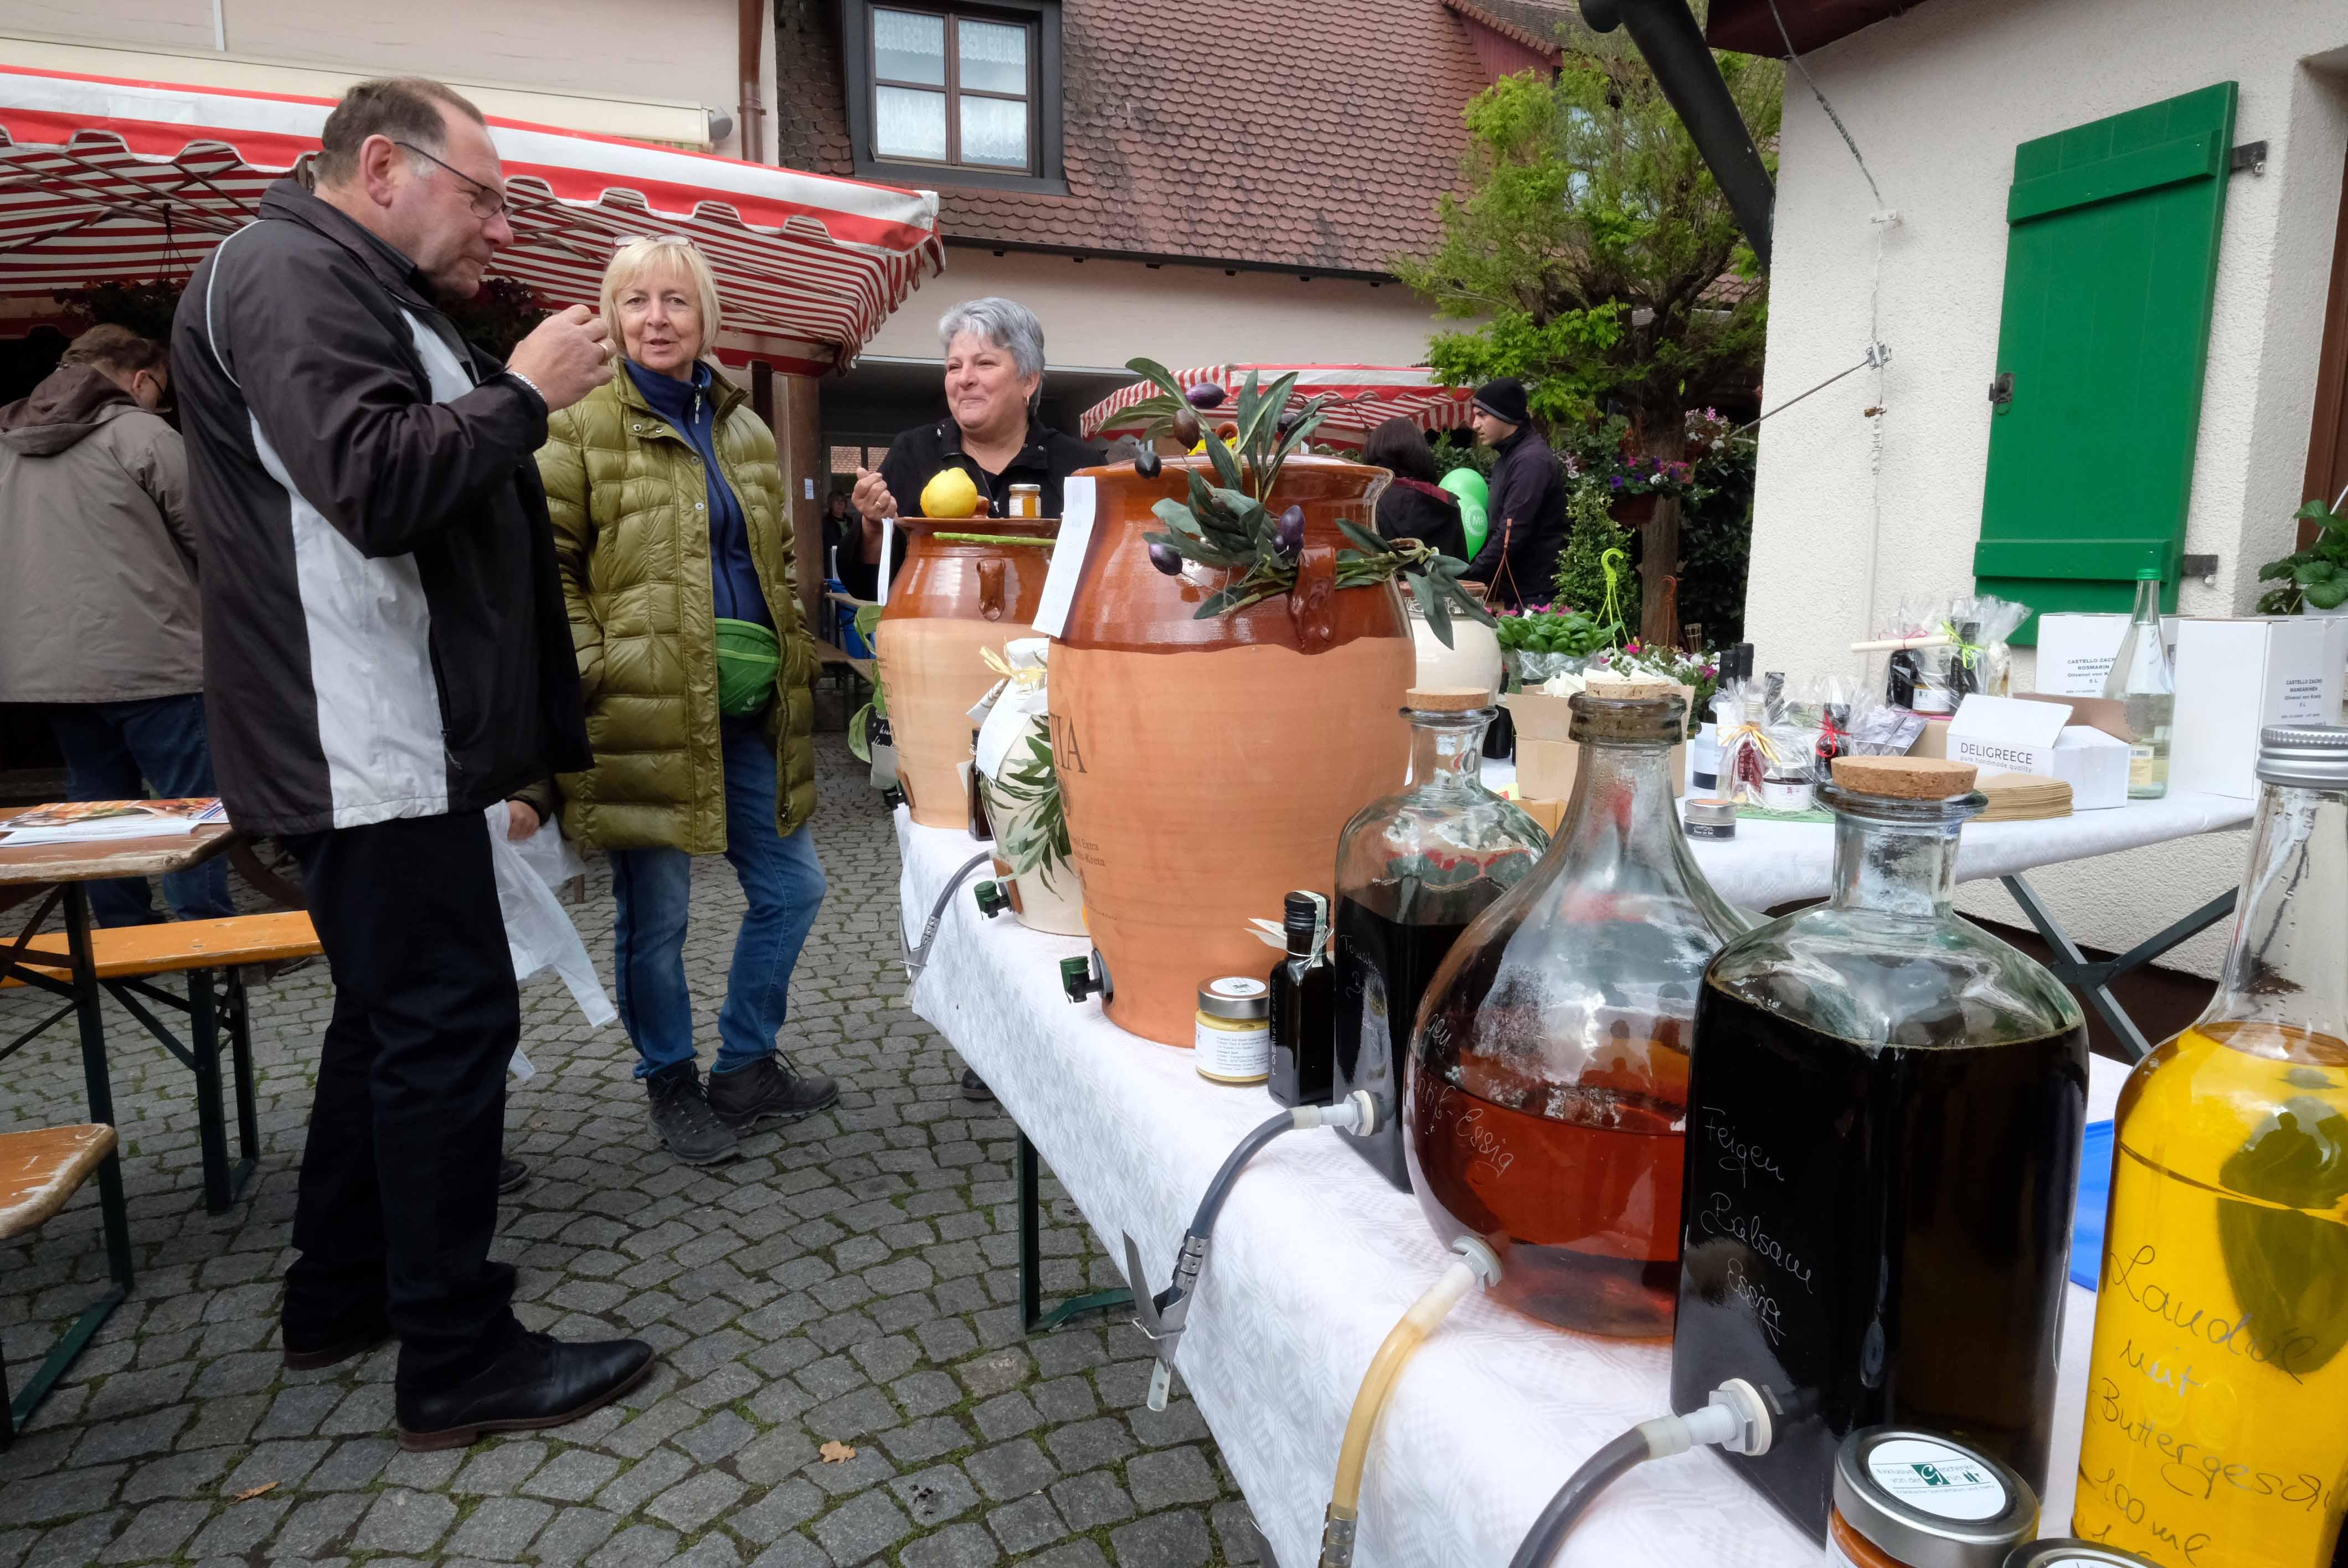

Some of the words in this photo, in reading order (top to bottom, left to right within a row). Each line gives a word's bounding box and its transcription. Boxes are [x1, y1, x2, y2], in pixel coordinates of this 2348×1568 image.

[1960, 742, 2033, 765] DELIGREECE
[1975, 757, 2007, 768] handmade
[2009, 764, 2033, 774] quality
[1456, 1108, 1514, 1178] Essig
[1702, 1106, 1785, 1188] Feigen
[1727, 1257, 1786, 1346] Essig
